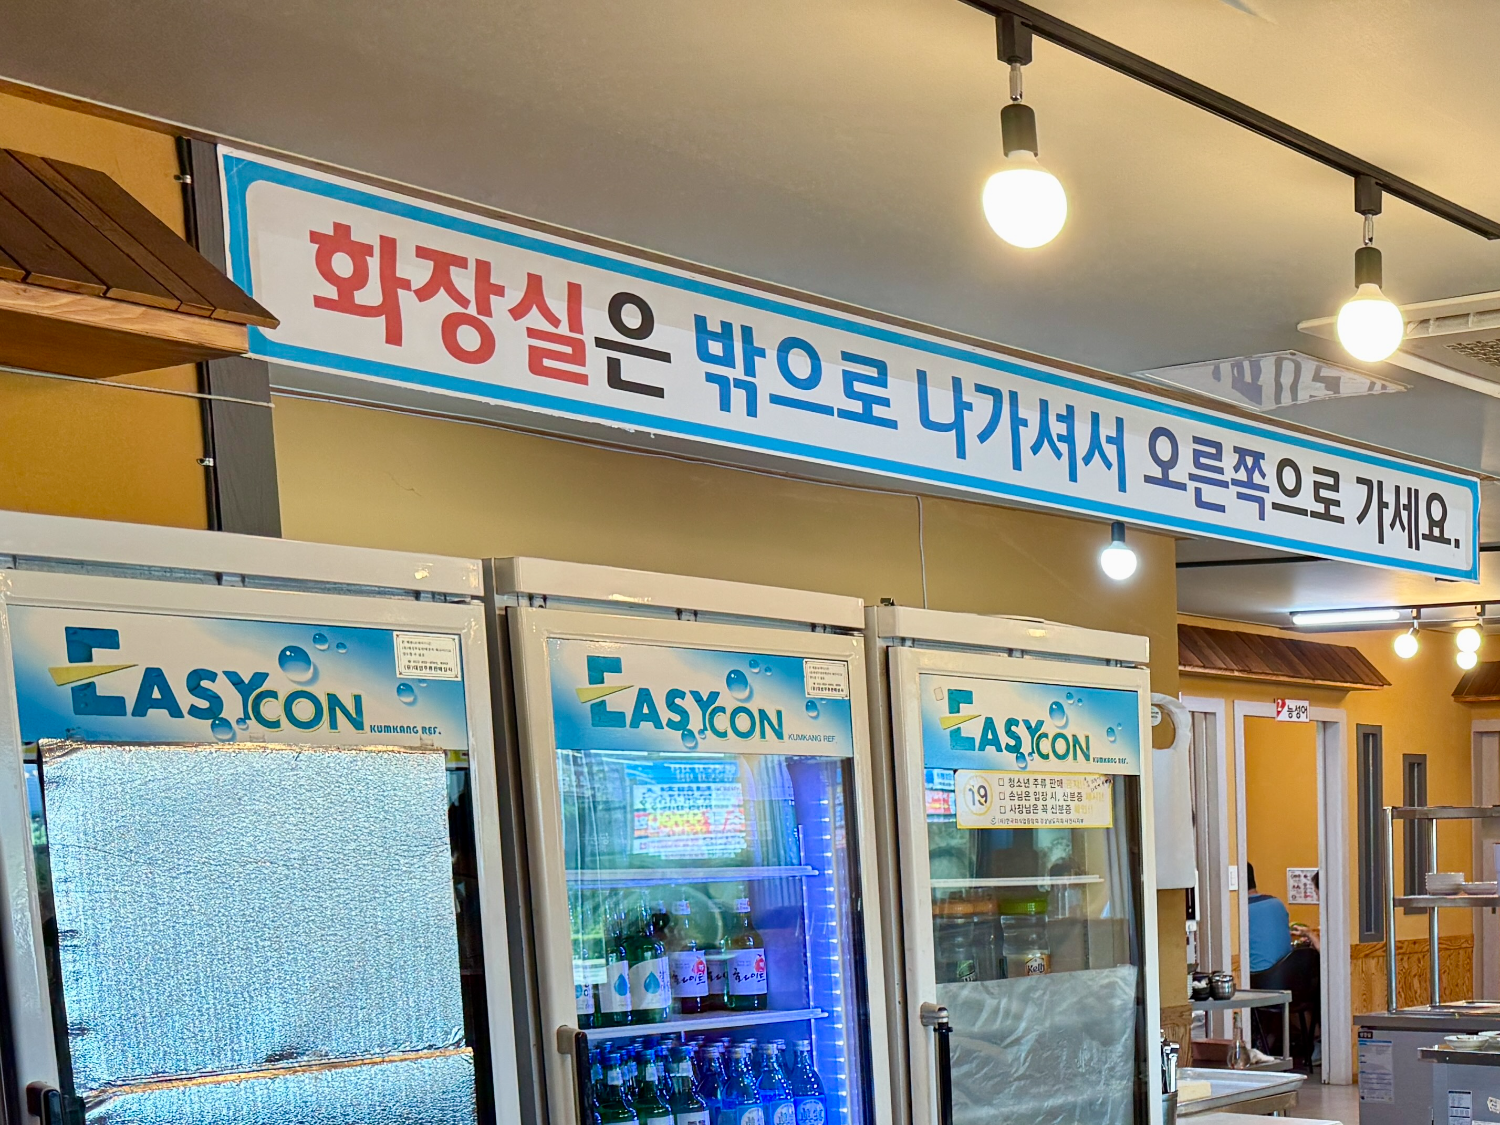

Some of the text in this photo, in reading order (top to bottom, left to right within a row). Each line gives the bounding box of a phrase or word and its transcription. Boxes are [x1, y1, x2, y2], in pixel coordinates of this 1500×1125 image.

[309, 221, 672, 398] 화장실은
[693, 313, 898, 430] 밖으로
[916, 369, 1127, 493] 나가셔서
[1143, 426, 1345, 524] 오른쪽으로
[1356, 476, 1461, 552] 가세요.
[1276, 699, 1283, 711] 2
[1286, 704, 1308, 719] 능성어
[369, 724, 419, 735] KUMKANG
[788, 733, 822, 743] KUMKANG
[1008, 778, 1031, 789] 청소년
[1033, 778, 1047, 789] 주류
[1049, 778, 1064, 789] 판매
[968, 784, 988, 807] 19
[1008, 791, 1031, 802] 손님은
[1062, 792, 1083, 802] 신분증
[1009, 804, 1039, 815] 사장님은
[1050, 804, 1072, 815] 신분증
